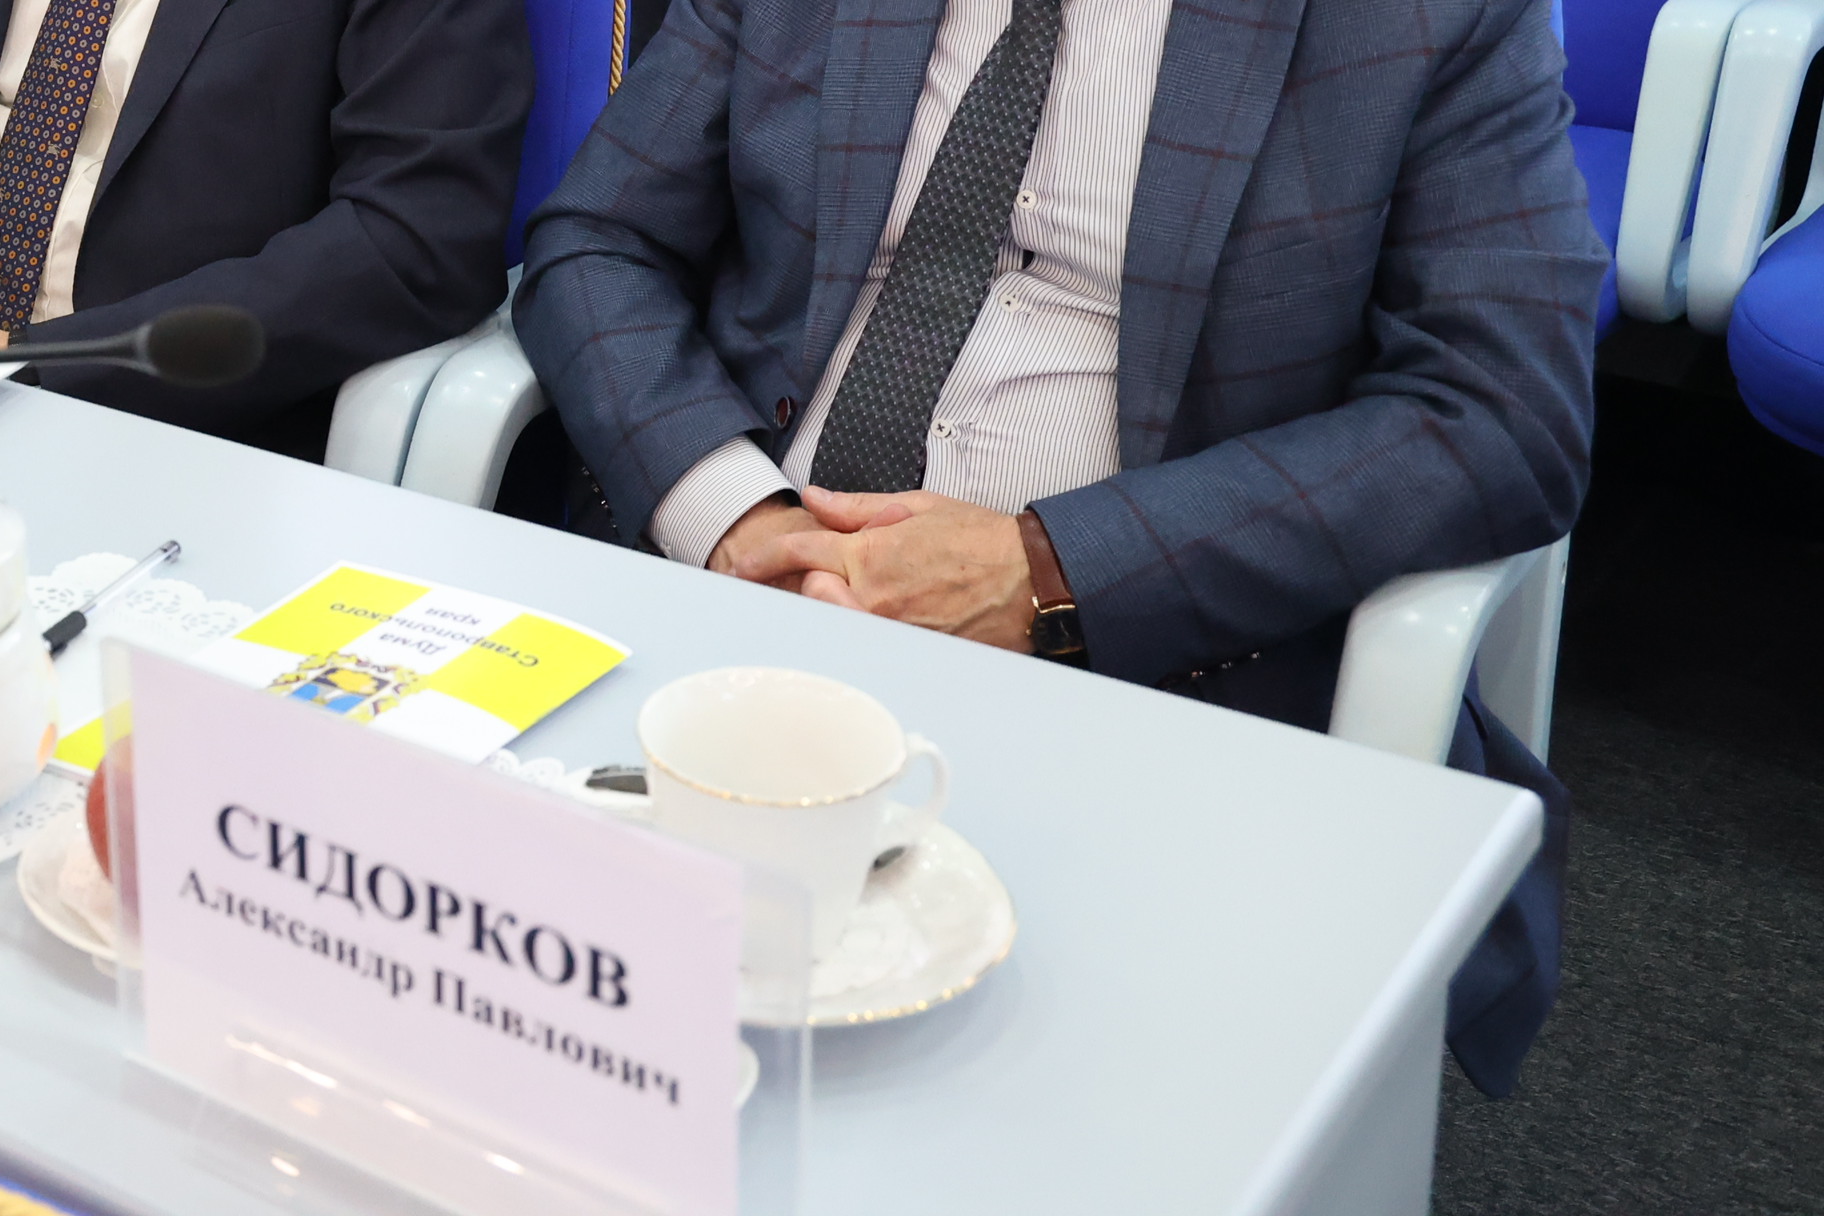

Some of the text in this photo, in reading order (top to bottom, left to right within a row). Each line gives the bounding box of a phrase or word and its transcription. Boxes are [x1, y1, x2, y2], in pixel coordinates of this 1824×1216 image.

[329, 602, 540, 668] Ставропольского
[379, 632, 448, 656] Дума
[425, 607, 482, 626] края
[215, 803, 632, 1010] СИДОРКОВ
[177, 868, 683, 1107] Александр Павлович
